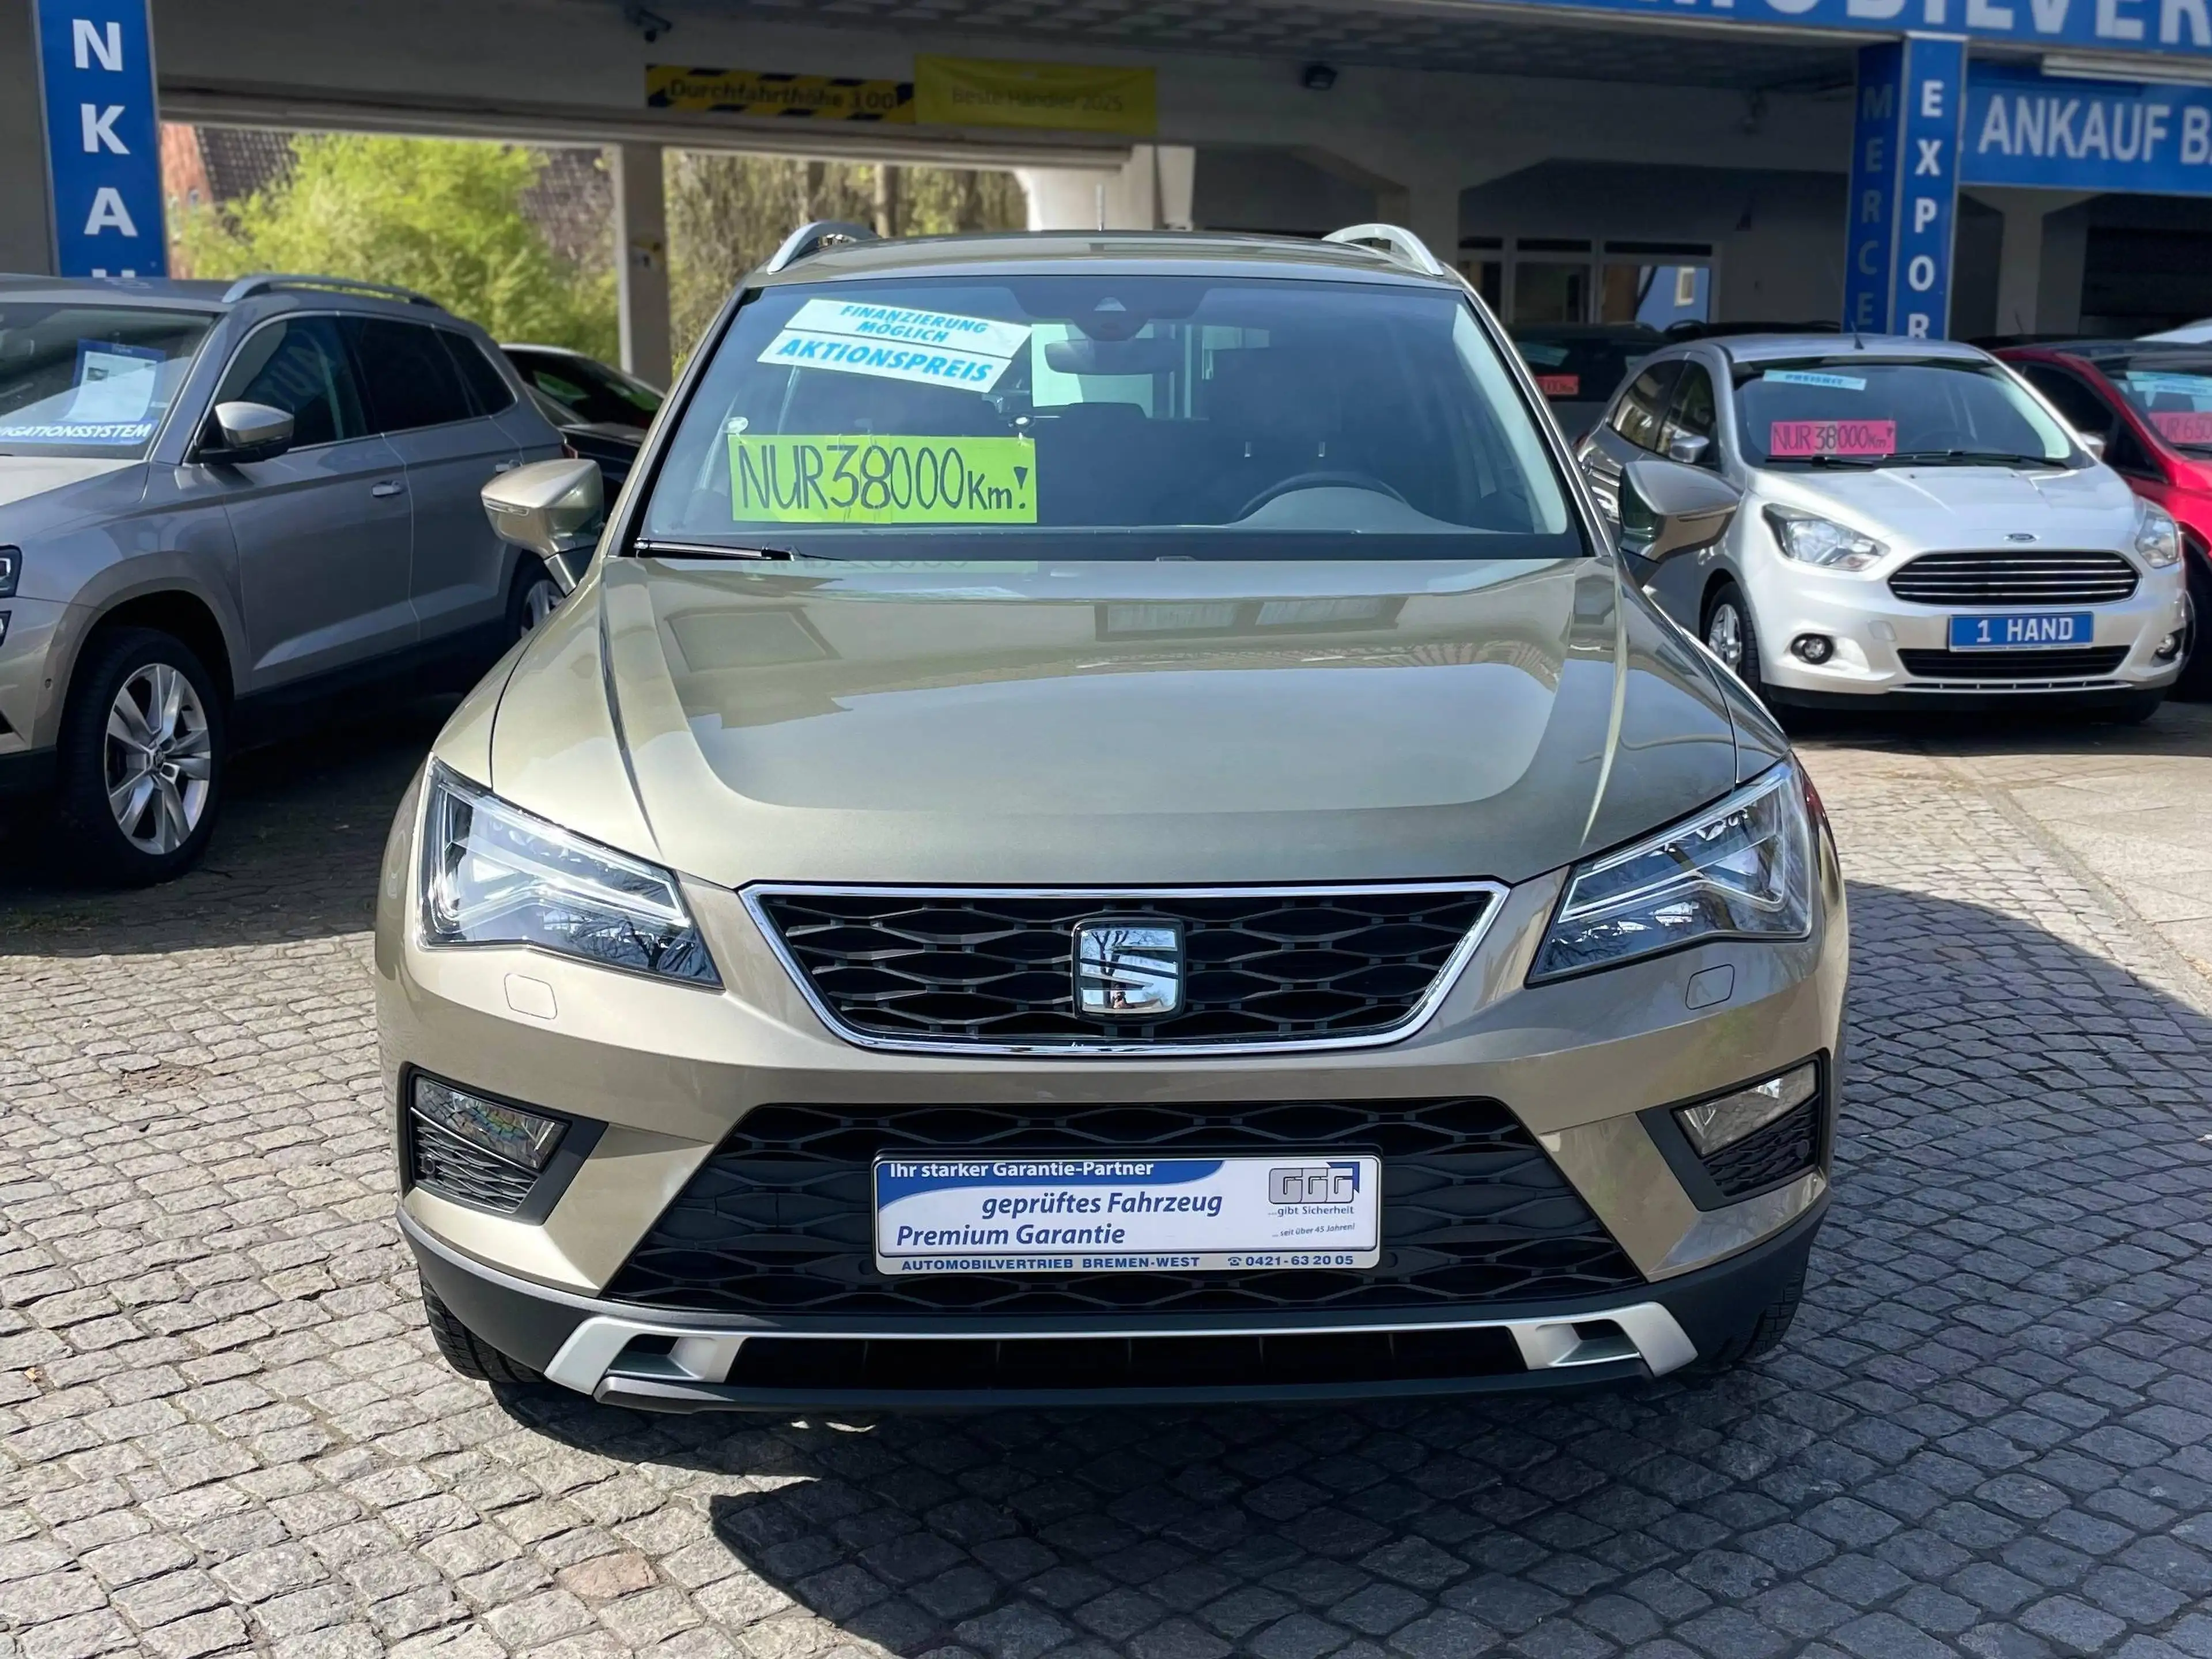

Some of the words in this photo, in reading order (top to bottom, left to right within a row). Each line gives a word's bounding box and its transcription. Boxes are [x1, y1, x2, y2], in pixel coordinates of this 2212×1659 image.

[1977, 94, 2171, 162] ANKAUF
[71, 18, 138, 278] NKA
[840, 305, 989, 334] FINANZIERUNG
[776, 338, 993, 384] AKTIONSPREIS
[0, 423, 152, 437] IGATIONSSYSTEM
[1976, 619, 1991, 643] 1
[2006, 618, 2074, 642] HAND
[890, 1163, 917, 1177] Ihr
[921, 1163, 989, 1177] starker
[993, 1161, 1154, 1177] Garantie-Partner
[982, 1191, 1101, 1219] geprüftes
[1107, 1191, 1223, 1217] Fahrzeug
[1302, 1205, 1355, 1215] Sicherheit
[897, 1224, 1008, 1246] Premium
[1016, 1223, 1125, 1244] Garantie
[1295, 1225, 1314, 1235] über
[1314, 1225, 1325, 1233] 45
[901, 1258, 1073, 1271] AUTOMOBILVERTRIEB
[1082, 1256, 1200, 1268] BREMEN-WEST
